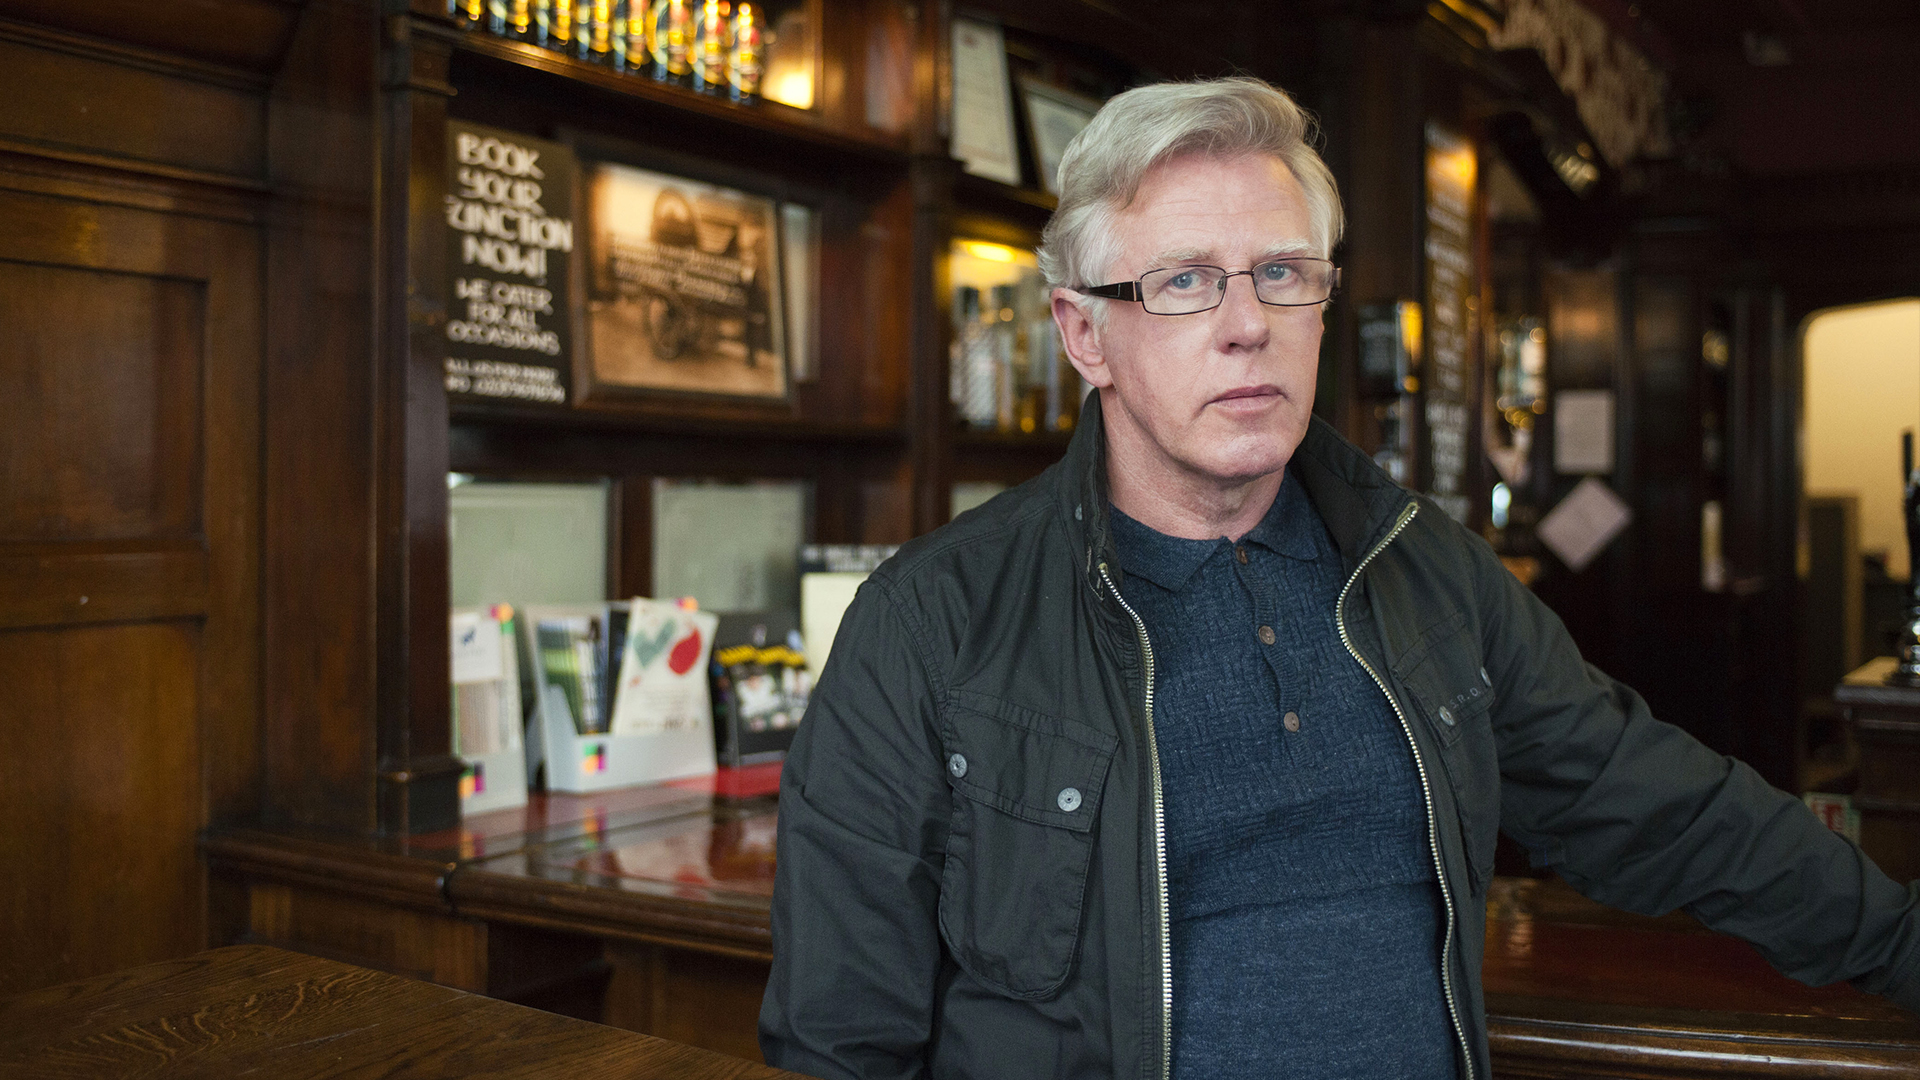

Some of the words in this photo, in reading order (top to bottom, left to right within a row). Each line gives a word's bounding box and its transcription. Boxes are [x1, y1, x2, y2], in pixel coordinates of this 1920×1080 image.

[457, 132, 544, 180] BOOK
[458, 166, 547, 218] YOUR
[456, 277, 491, 301] WE
[491, 282, 553, 315] CATER
[467, 300, 508, 326] FOR
[508, 306, 541, 332] ALL
[446, 320, 561, 356] OCCASIONS
